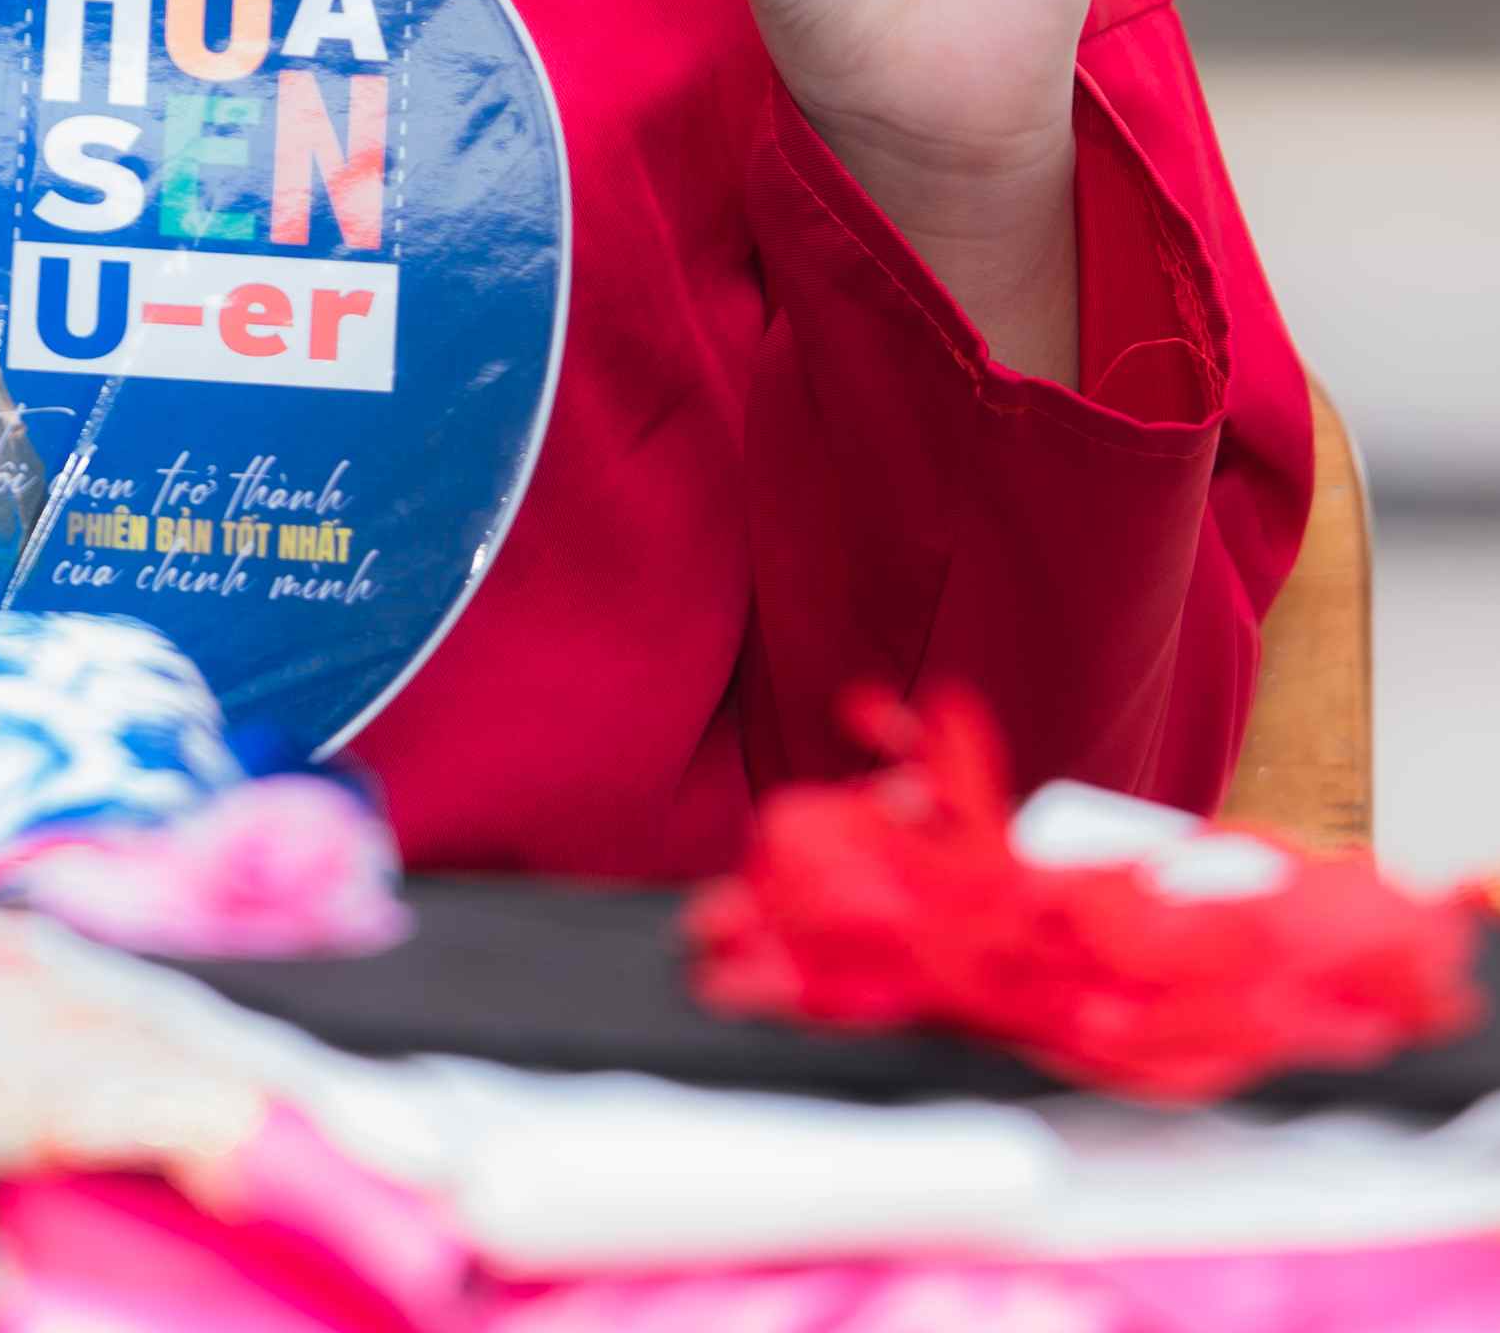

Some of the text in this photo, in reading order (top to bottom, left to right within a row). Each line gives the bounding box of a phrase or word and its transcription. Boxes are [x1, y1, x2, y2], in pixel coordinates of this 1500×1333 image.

[32, 69, 388, 250] SEN
[36, 257, 375, 361] U-er
[151, 450, 218, 515] trở
[224, 455, 354, 519] thành
[67, 505, 353, 564] PHIÊN BẢN TỐT NHẤT
[52, 539, 384, 605] của chính mình
